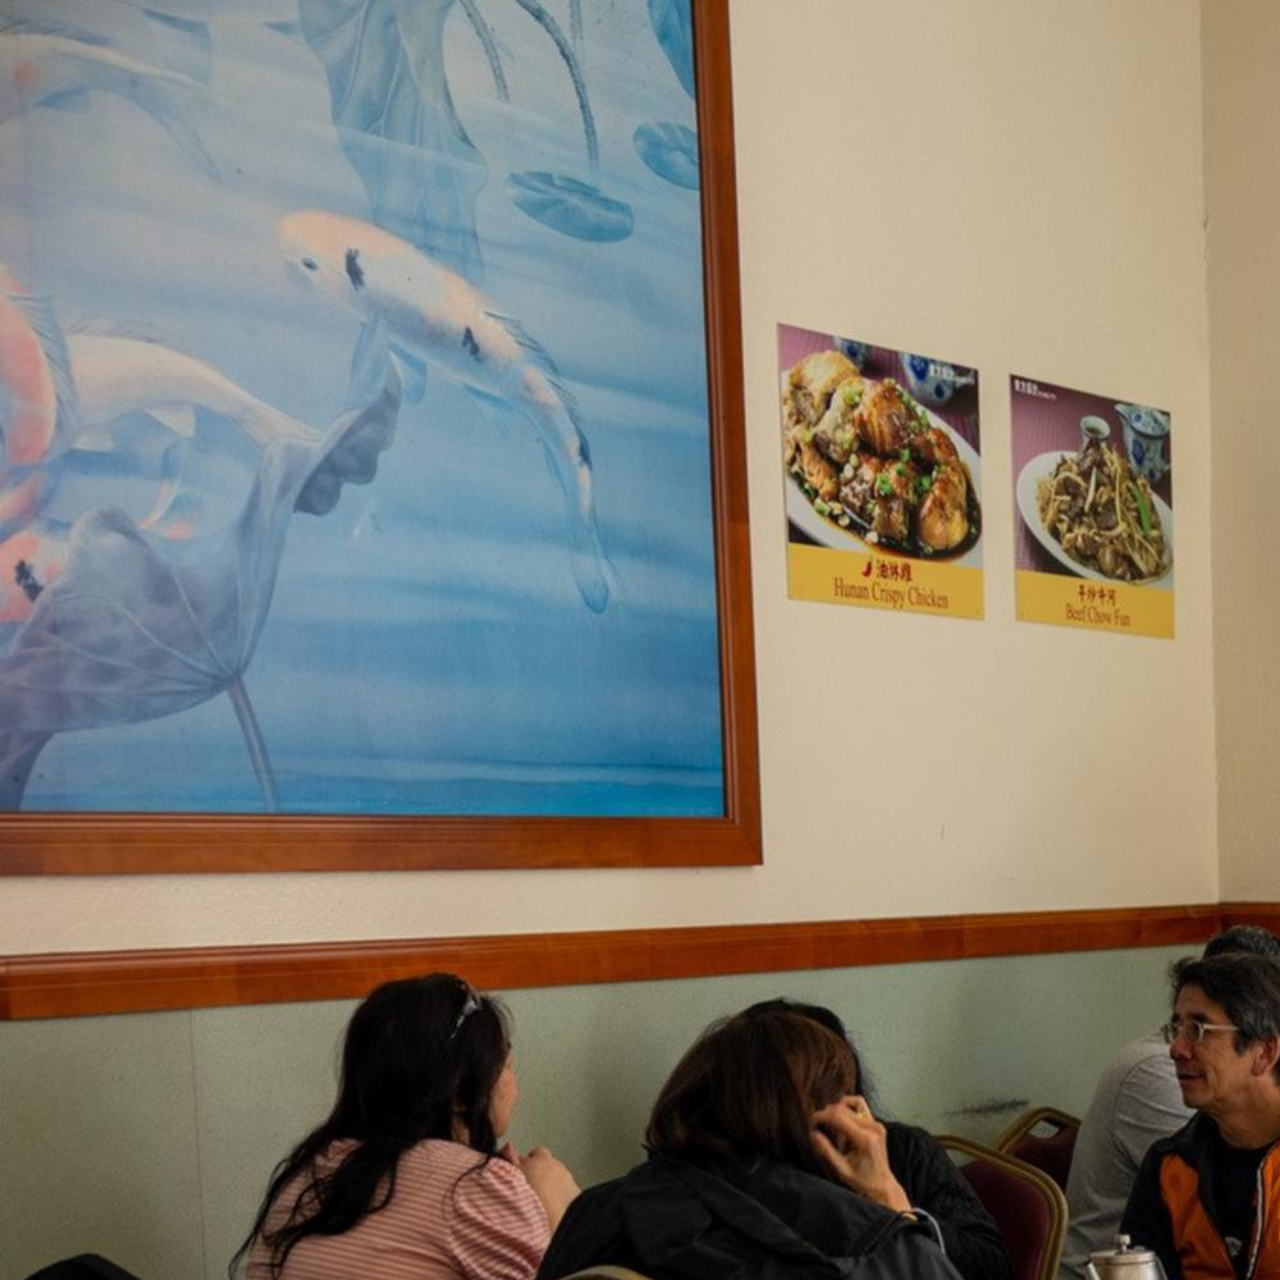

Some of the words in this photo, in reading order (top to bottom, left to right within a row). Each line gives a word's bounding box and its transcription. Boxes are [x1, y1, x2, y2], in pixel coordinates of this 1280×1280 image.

[834, 578, 870, 600] Hunan
[872, 583, 904, 609] Crispy
[908, 586, 949, 609] Chicken
[1066, 603, 1086, 621] Beef
[1088, 607, 1111, 625] Chow
[1114, 610, 1130, 626] Fun
